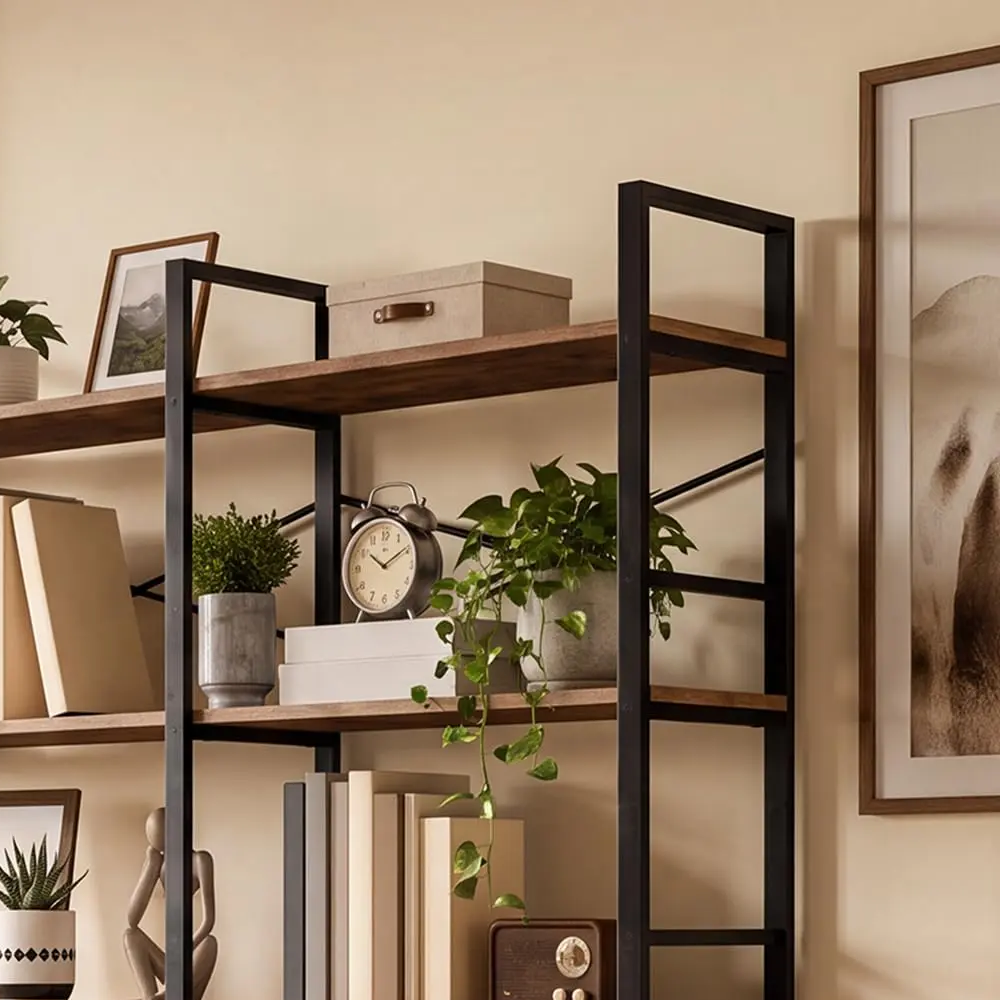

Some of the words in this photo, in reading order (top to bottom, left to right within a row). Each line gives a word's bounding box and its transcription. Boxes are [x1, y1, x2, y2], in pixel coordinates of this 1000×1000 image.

[370, 535, 376, 545] 11
[381, 531, 390, 541] 12
[396, 533, 401, 543] 1
[370, 591, 375, 601] 7
[381, 594, 387, 604] 6
